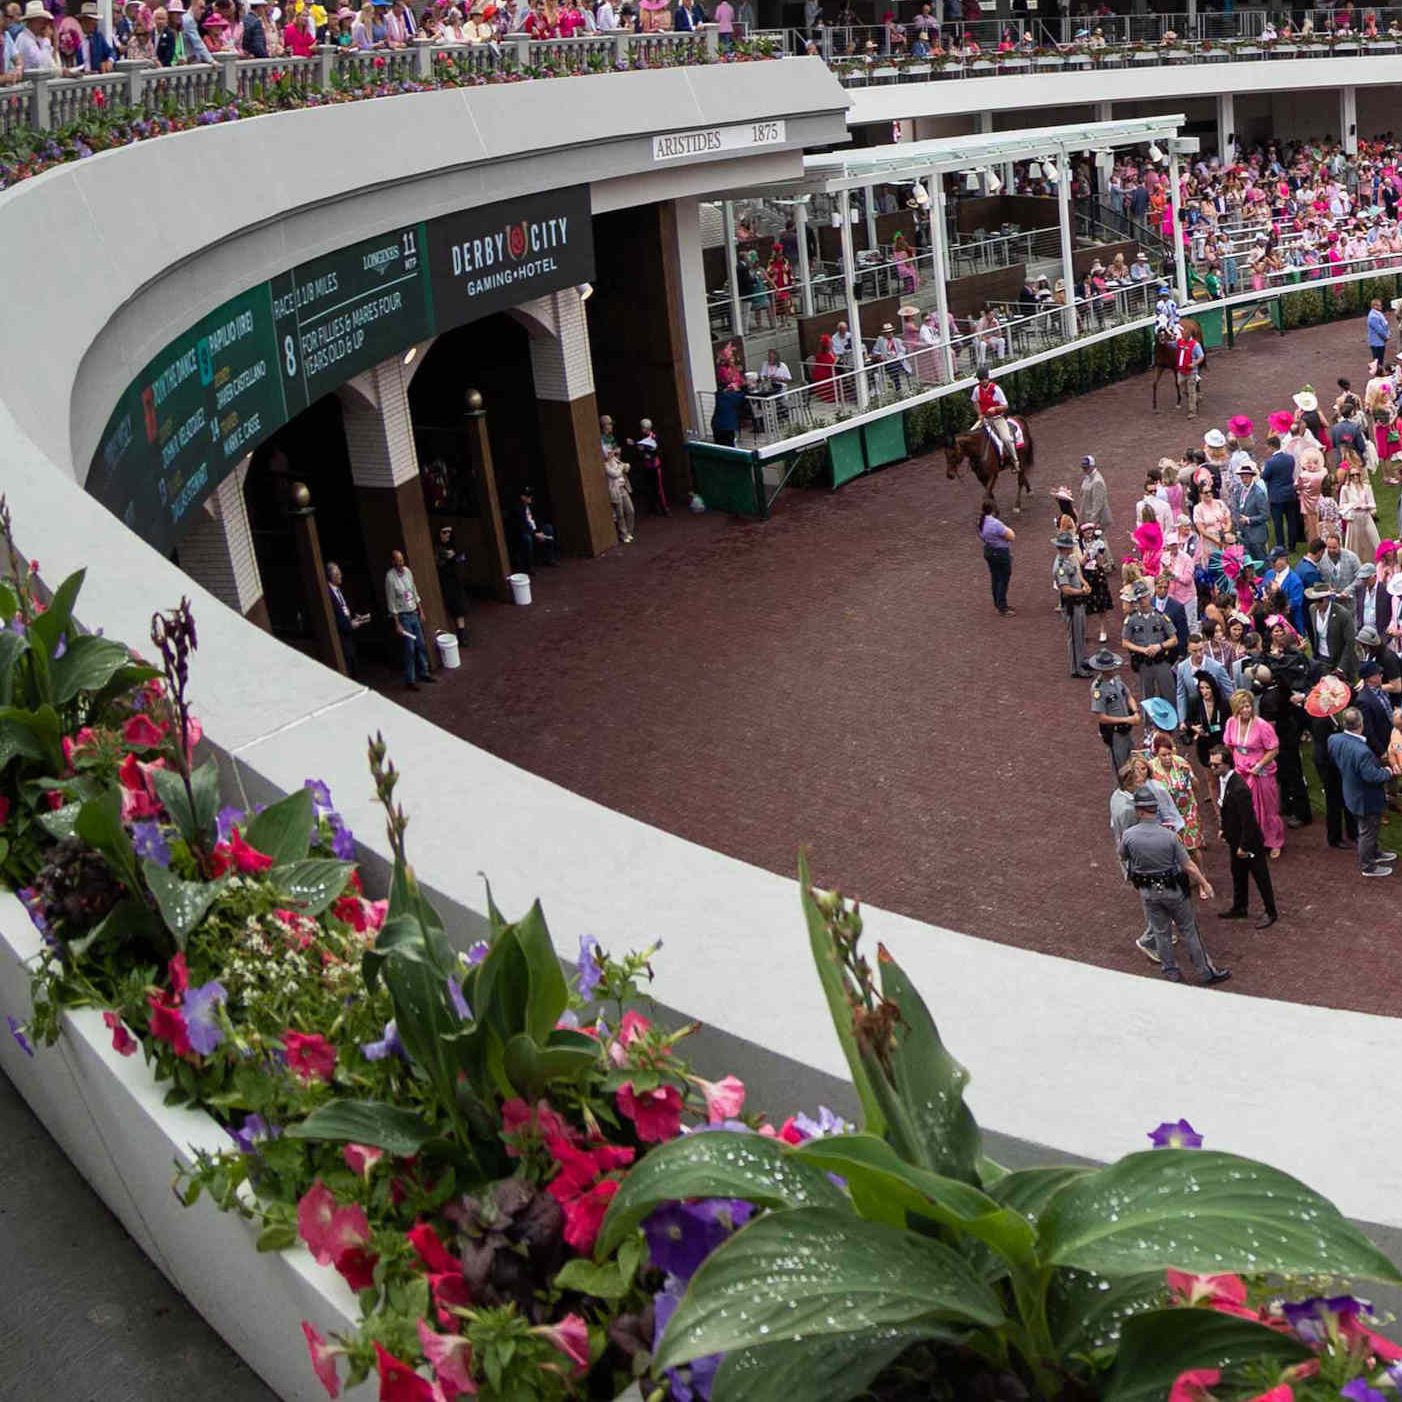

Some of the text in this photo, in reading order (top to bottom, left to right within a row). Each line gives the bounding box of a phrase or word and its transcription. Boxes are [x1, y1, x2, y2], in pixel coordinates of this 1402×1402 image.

[656, 131, 721, 157] ARISTIDES
[752, 123, 778, 142] 1875
[402, 231, 416, 255] 11
[452, 217, 567, 276] DERBY CITY
[314, 272, 338, 298] MILES
[273, 289, 295, 319] RACE
[301, 331, 319, 354] FOR
[318, 317, 345, 346] FILLIES
[352, 301, 379, 328] MARES
[378, 292, 402, 319] FOUR
[284, 335, 296, 377] 8
[304, 348, 329, 378] YEARS
[328, 341, 346, 364] OLD
[353, 329, 365, 351] UP
